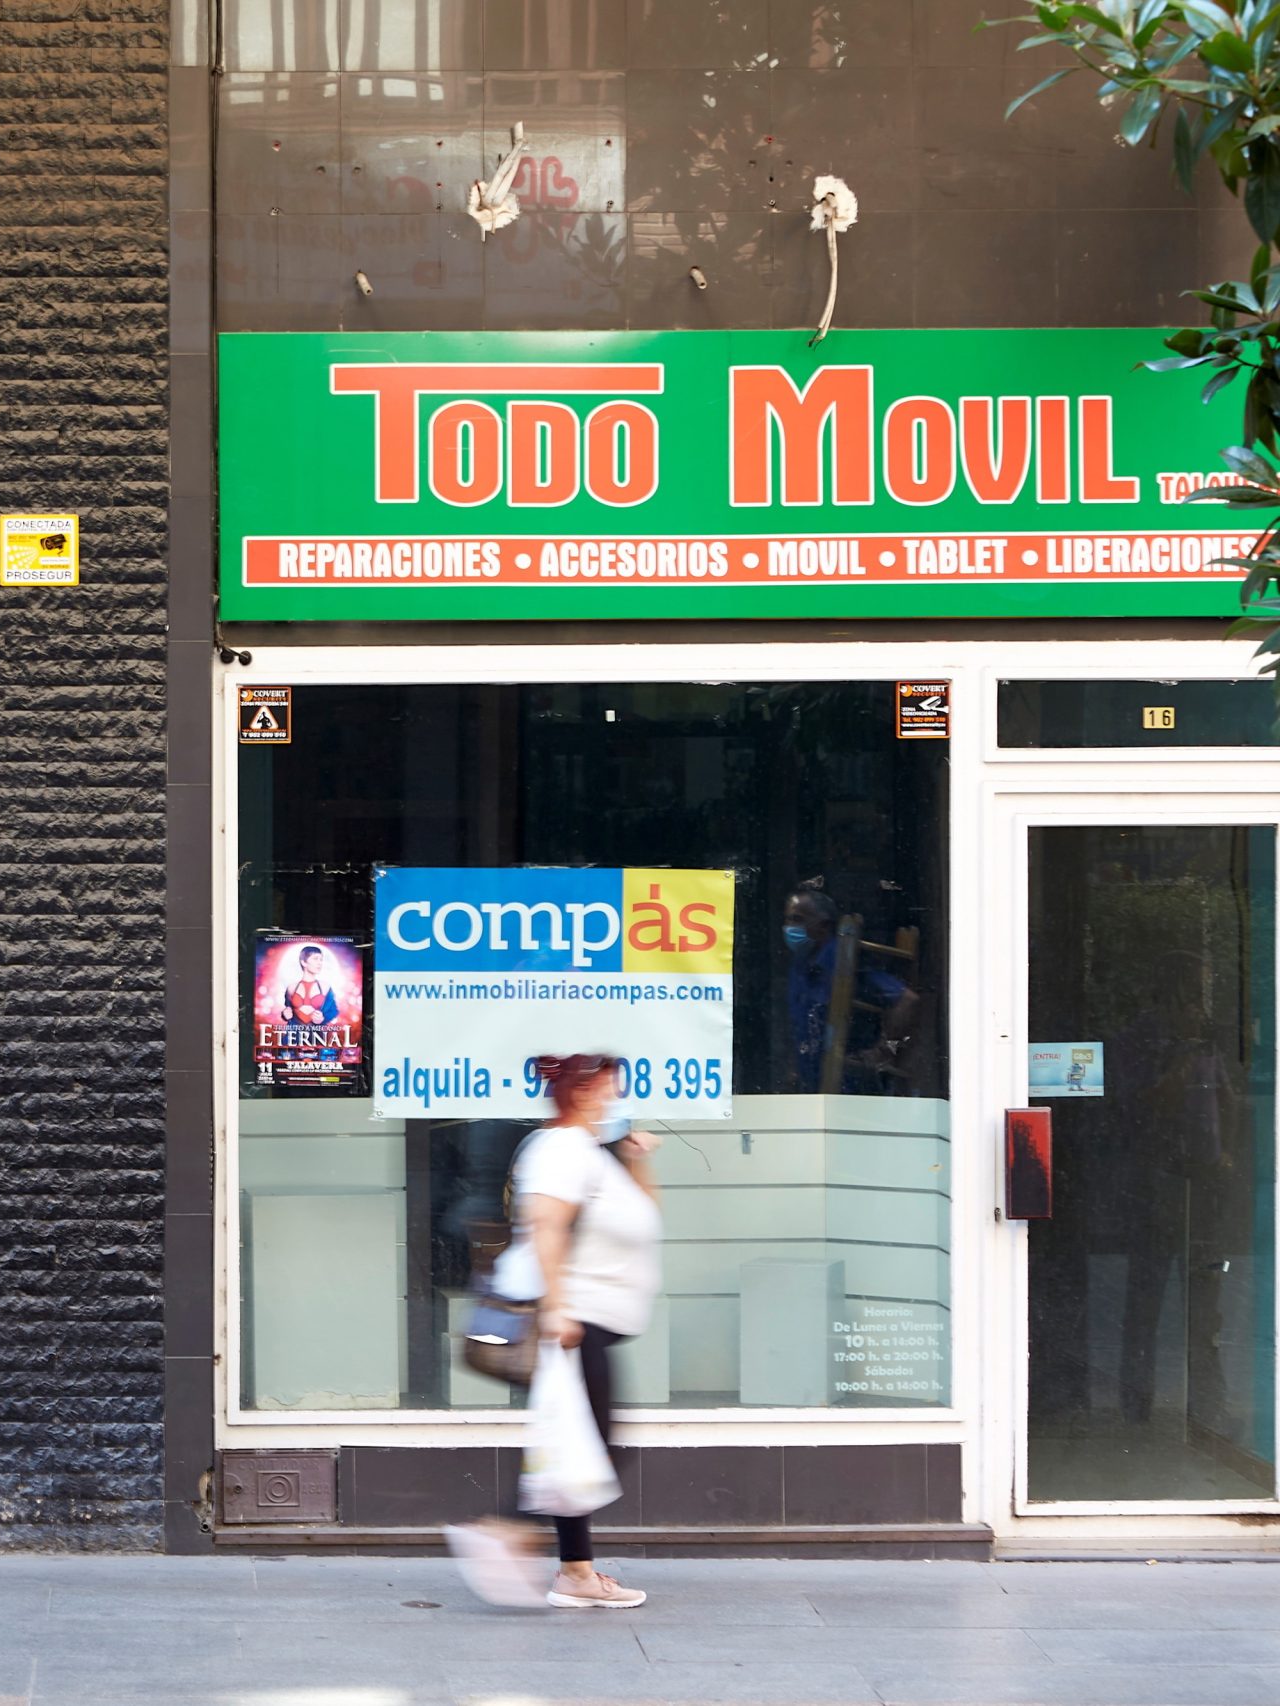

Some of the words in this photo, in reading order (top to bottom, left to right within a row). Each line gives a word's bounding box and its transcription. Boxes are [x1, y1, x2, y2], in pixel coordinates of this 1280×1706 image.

[329, 361, 665, 508] TODO
[728, 364, 1140, 506] MOVIL
[6, 520, 72, 529] CONECTADA
[277, 540, 501, 579] REPARACIONES
[539, 539, 729, 578] ACCESORIOS
[768, 538, 866, 577] MOVIL
[903, 537, 1008, 576] TABLET
[6, 571, 72, 580] PROSEGUR
[1149, 709, 1172, 727] 16
[385, 979, 724, 1004] www.inmobiliariacompas.com
[259, 1023, 358, 1047] ETERNAL
[383, 1057, 491, 1108] alquila
[613, 1057, 652, 1099] 08
[664, 1058, 721, 1099] 395
[863, 1306, 913, 1317] Horario:
[833, 1321, 851, 1332] De
[853, 1322, 888, 1332] Lunes
[901, 1321, 944, 1332] Viernes
[845, 1335, 864, 1348] 10
[867, 1336, 880, 1346] h.
[881, 1338, 891, 1347] a
[927, 1335, 940, 1346] h.
[833, 1352, 866, 1361] 17:00
[868, 1351, 880, 1361] h.
[882, 1352, 892, 1361] a
[893, 1351, 930, 1361] 20:00
[932, 1350, 945, 1361] h.
[863, 1365, 914, 1377] Sábados
[834, 1381, 869, 1391] 10:00
[870, 1380, 884, 1391] h.
[885, 1382, 895, 1391] a
[896, 1381, 930, 1391] 14:00
[931, 1379, 944, 1390] h.
